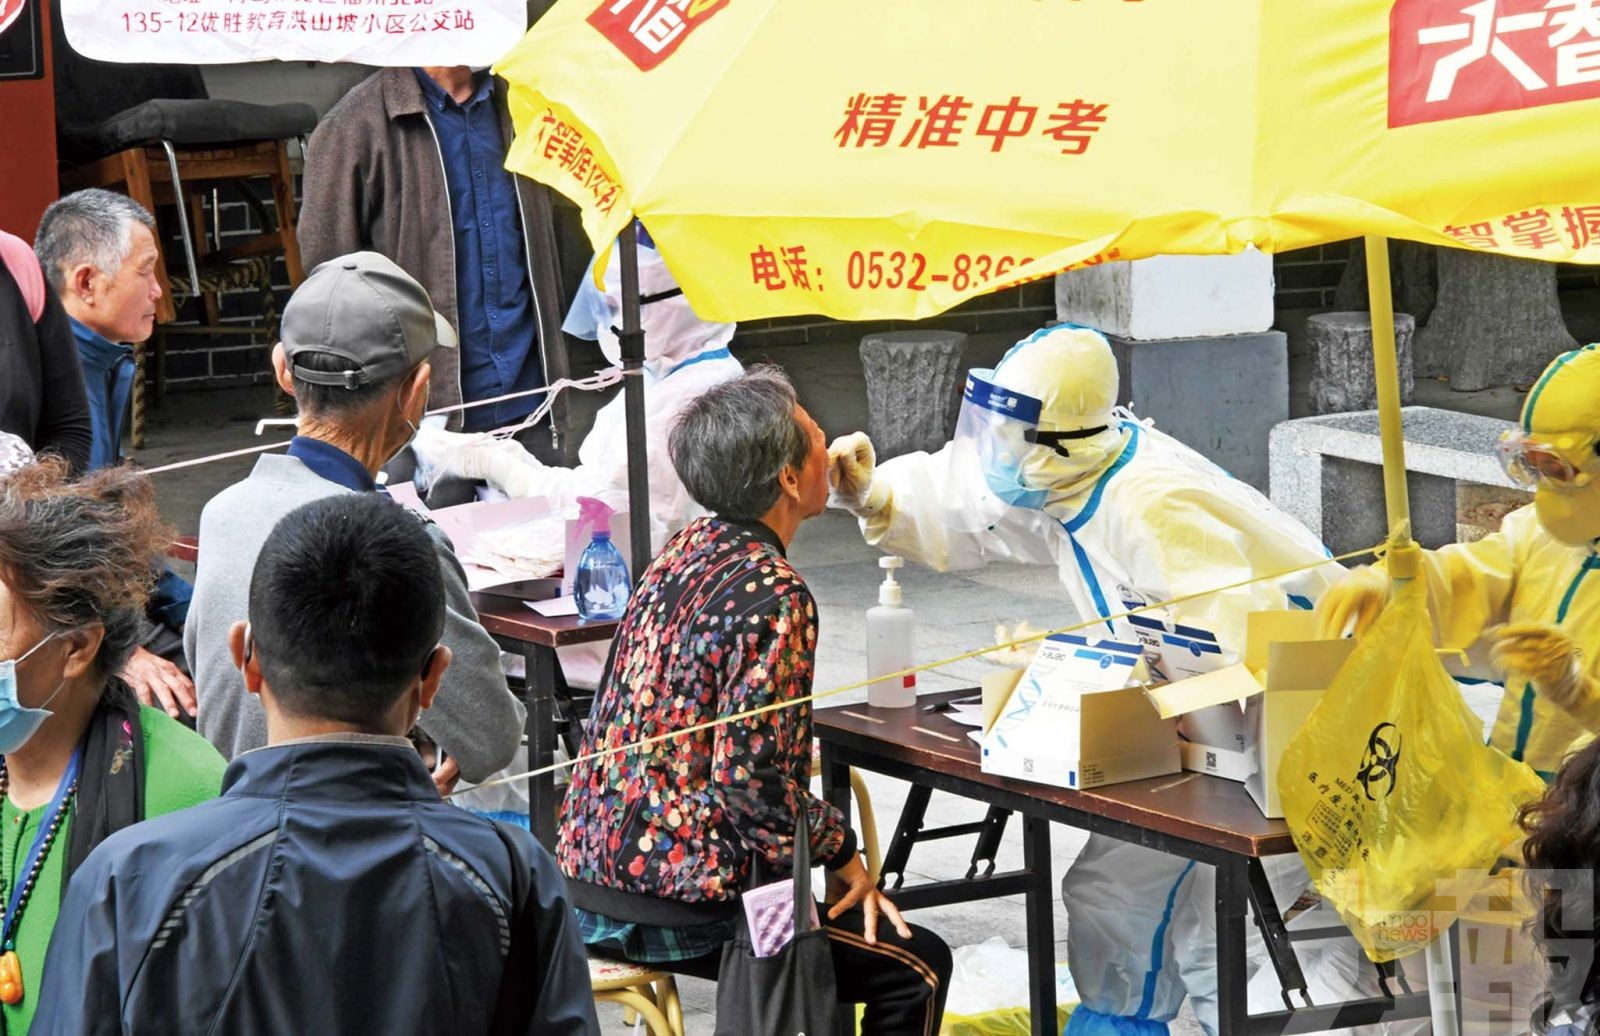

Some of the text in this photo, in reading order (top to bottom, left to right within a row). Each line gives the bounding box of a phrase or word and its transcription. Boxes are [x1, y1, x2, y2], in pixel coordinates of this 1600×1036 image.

[121, 9, 475, 34] 135-12优胜教育洪山坡小区公交站
[833, 93, 1110, 155] 精准中考
